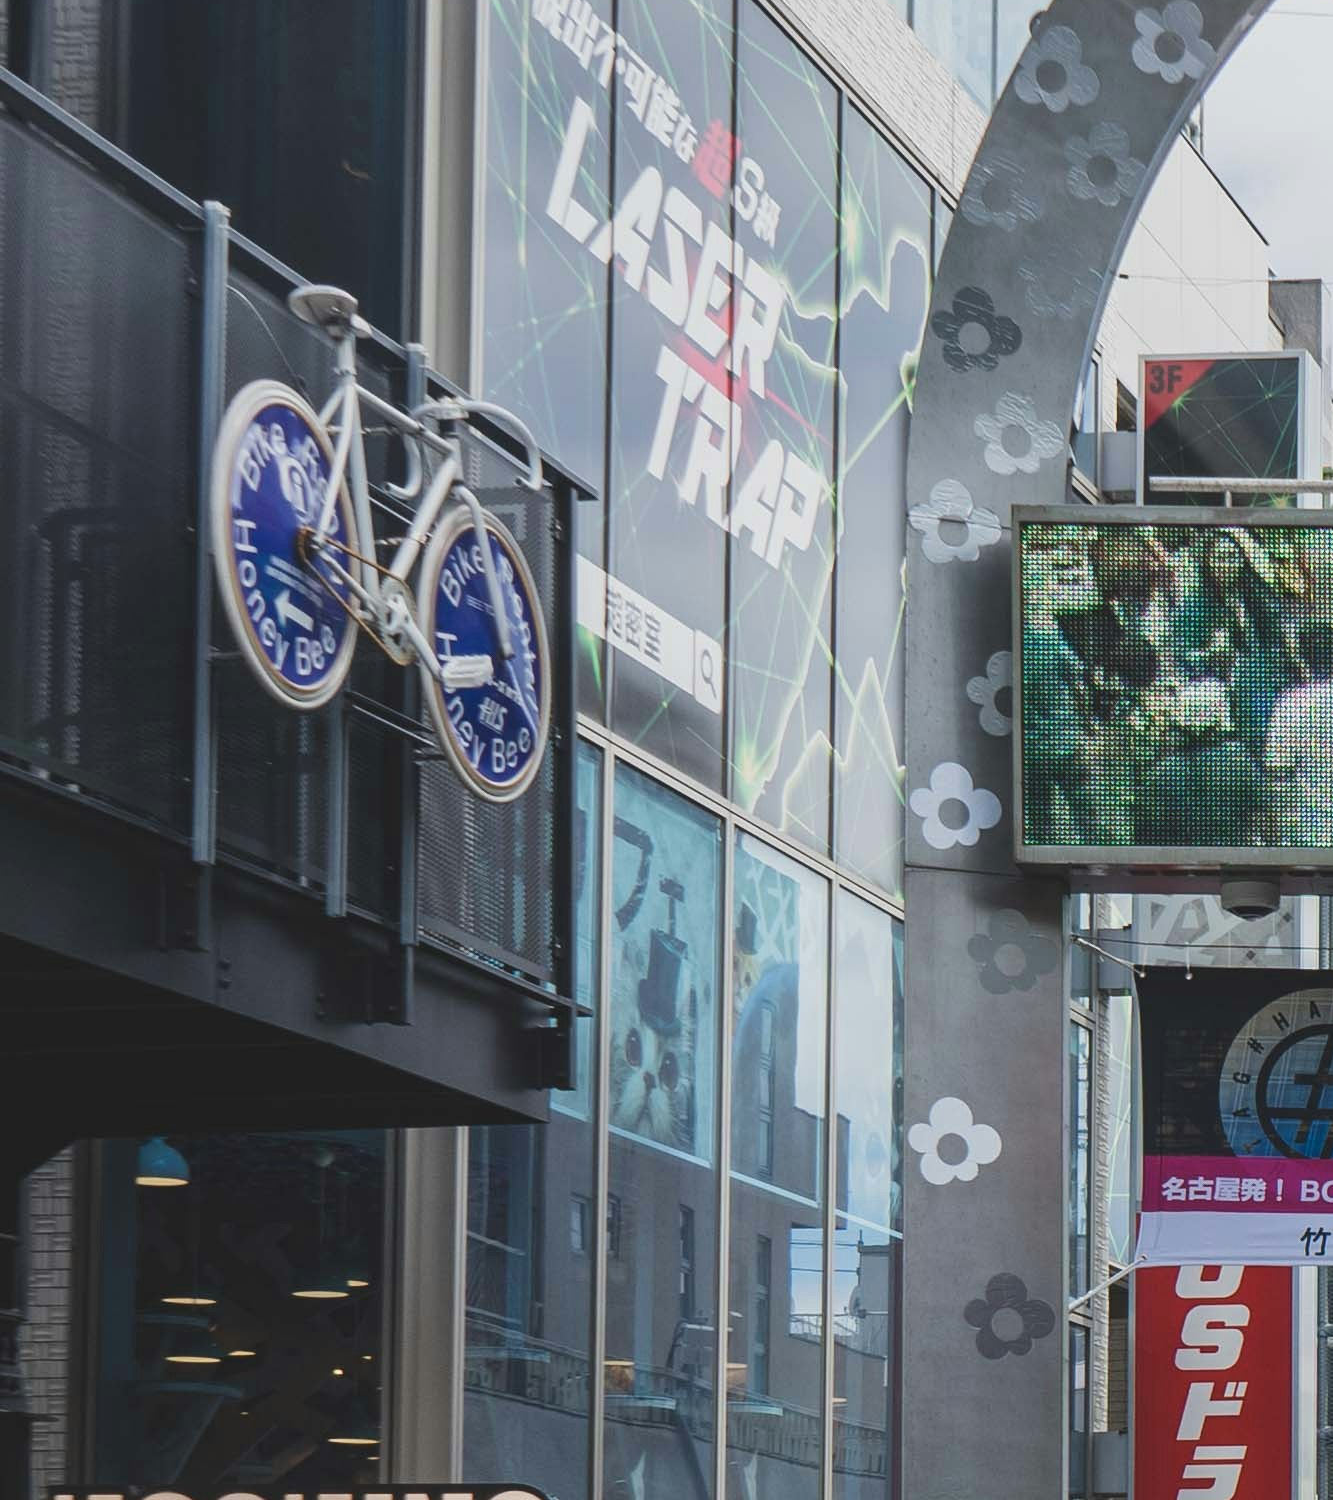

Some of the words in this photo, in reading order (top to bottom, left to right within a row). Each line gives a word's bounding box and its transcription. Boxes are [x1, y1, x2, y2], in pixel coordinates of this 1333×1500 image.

[546, 95, 788, 401] LASER
[1149, 365, 1183, 394] 3F
[646, 343, 828, 571] TRAP
[440, 545, 486, 608] Bike
[296, 624, 337, 676] Bee
[491, 726, 533, 774] Bee
